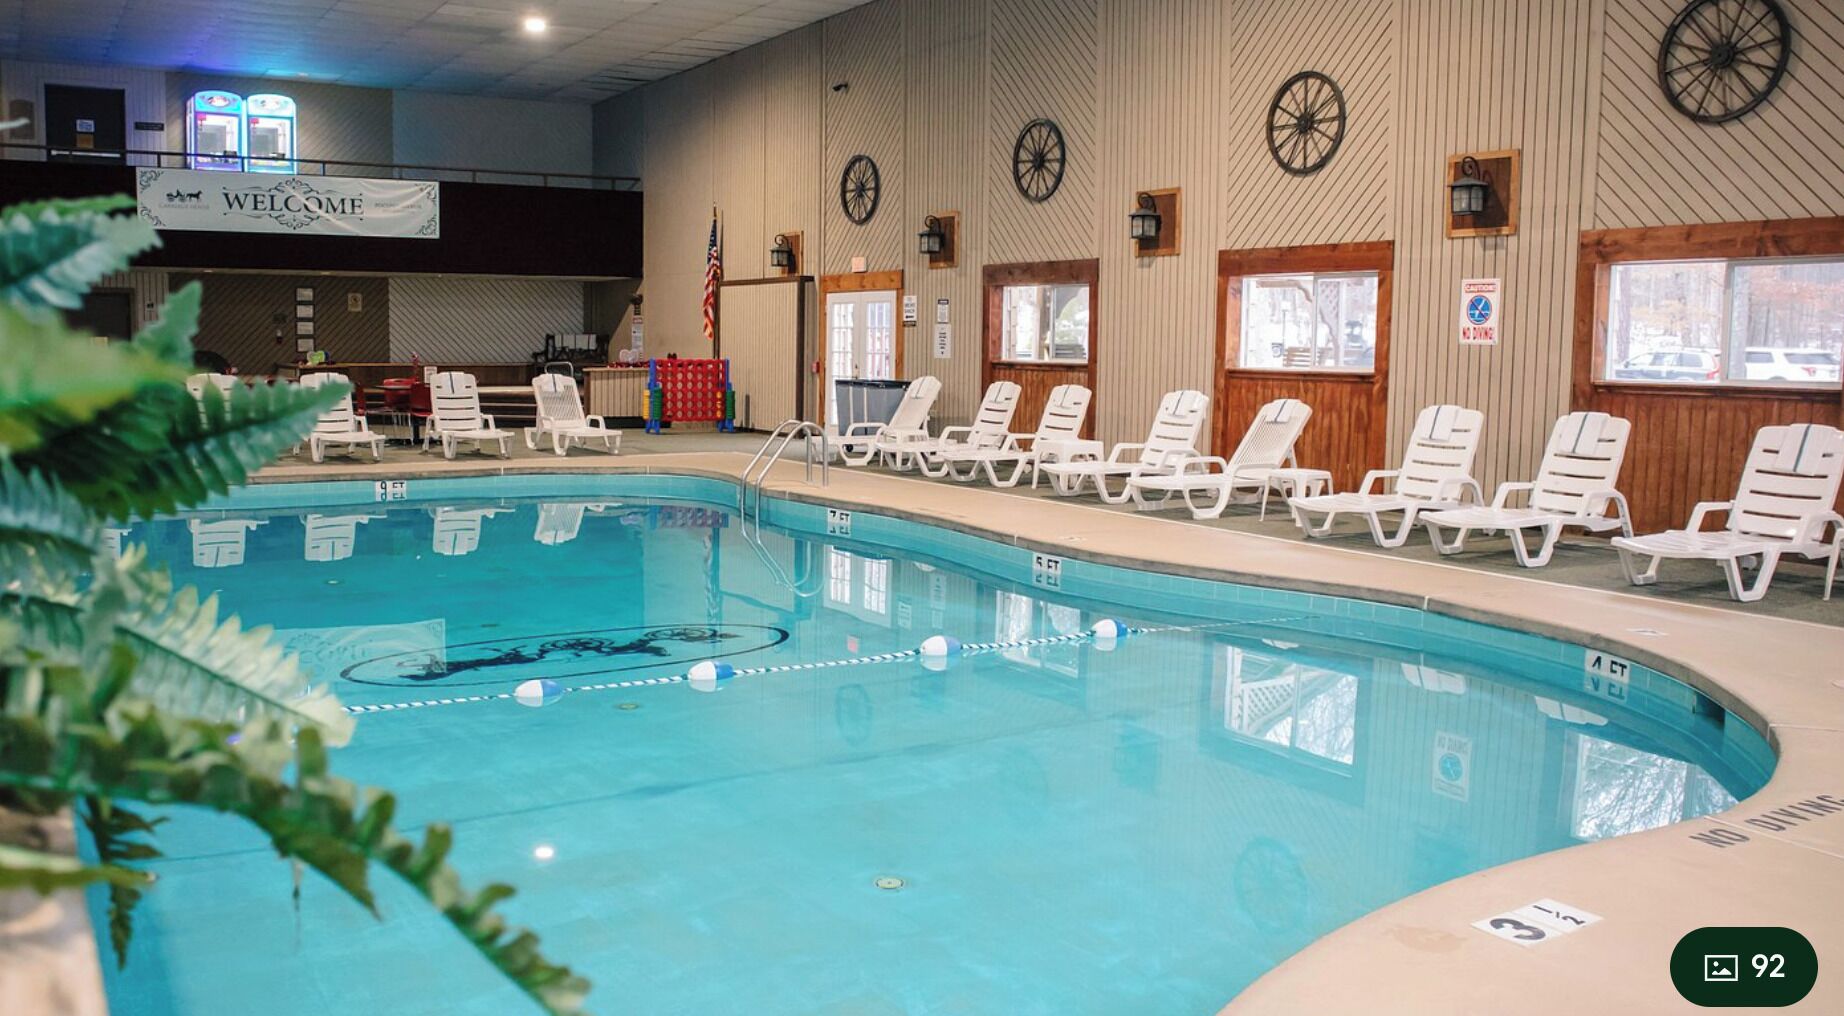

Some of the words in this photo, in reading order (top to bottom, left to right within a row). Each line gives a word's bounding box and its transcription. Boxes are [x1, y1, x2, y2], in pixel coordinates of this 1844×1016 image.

[223, 191, 364, 215] WELCOME
[1463, 327, 1471, 340] NO
[1688, 828, 1750, 848] NO
[1489, 918, 1546, 940] 3
